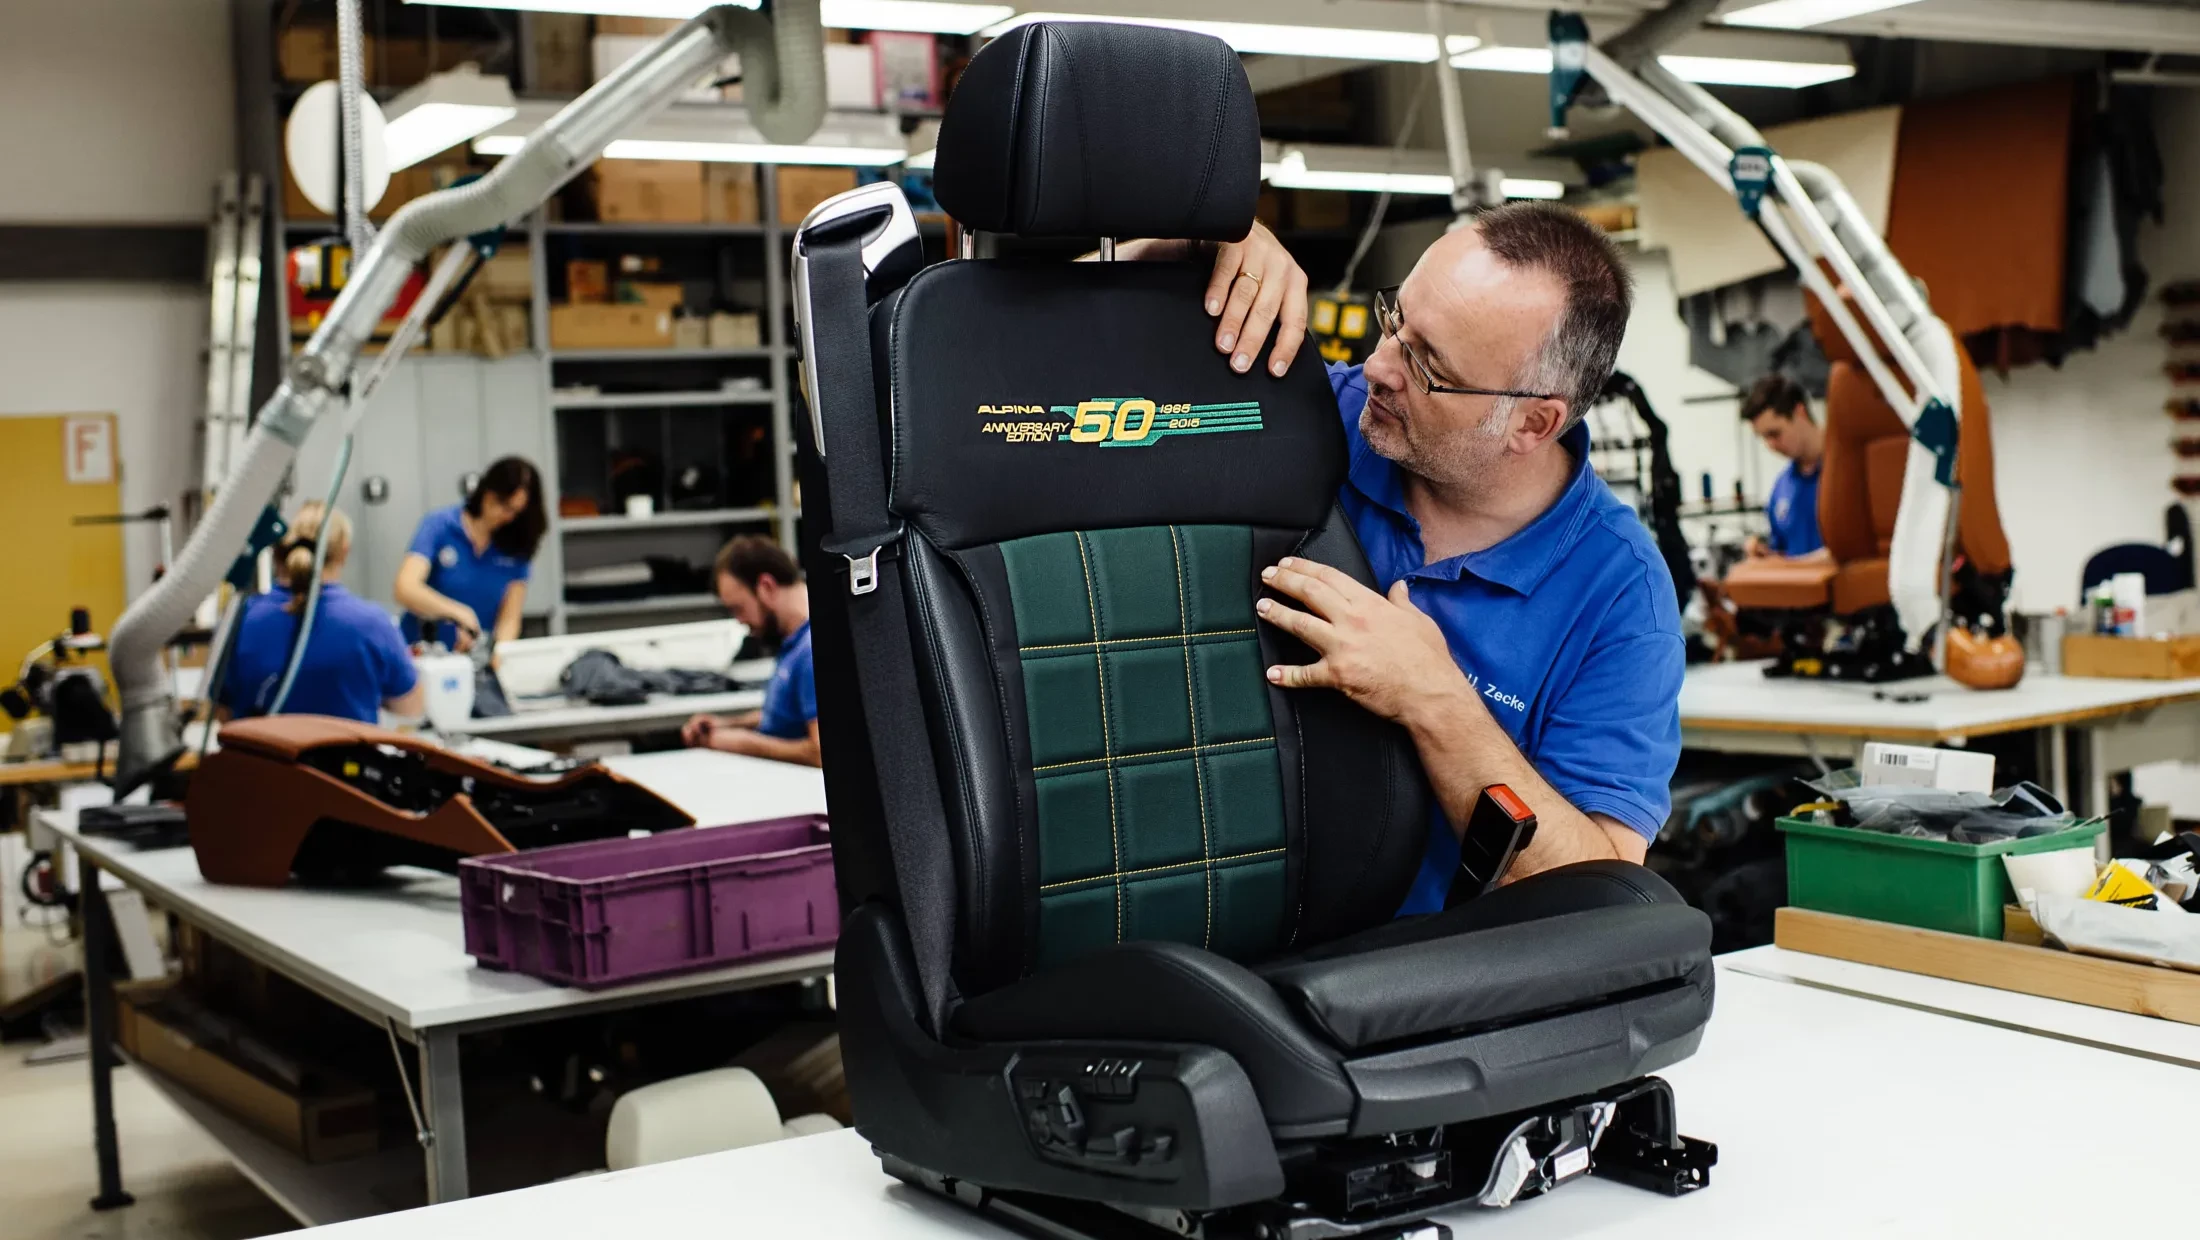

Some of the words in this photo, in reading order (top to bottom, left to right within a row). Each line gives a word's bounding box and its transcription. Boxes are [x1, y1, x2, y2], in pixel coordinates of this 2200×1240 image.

[978, 404, 1045, 414] ALPINA
[1070, 399, 1156, 443] 50
[1169, 418, 1200, 428] 2015
[982, 422, 1070, 433] ANNIVERSARY
[1006, 431, 1052, 442] EDITION
[75, 424, 101, 472] F
[1484, 683, 1525, 712] Zecke
